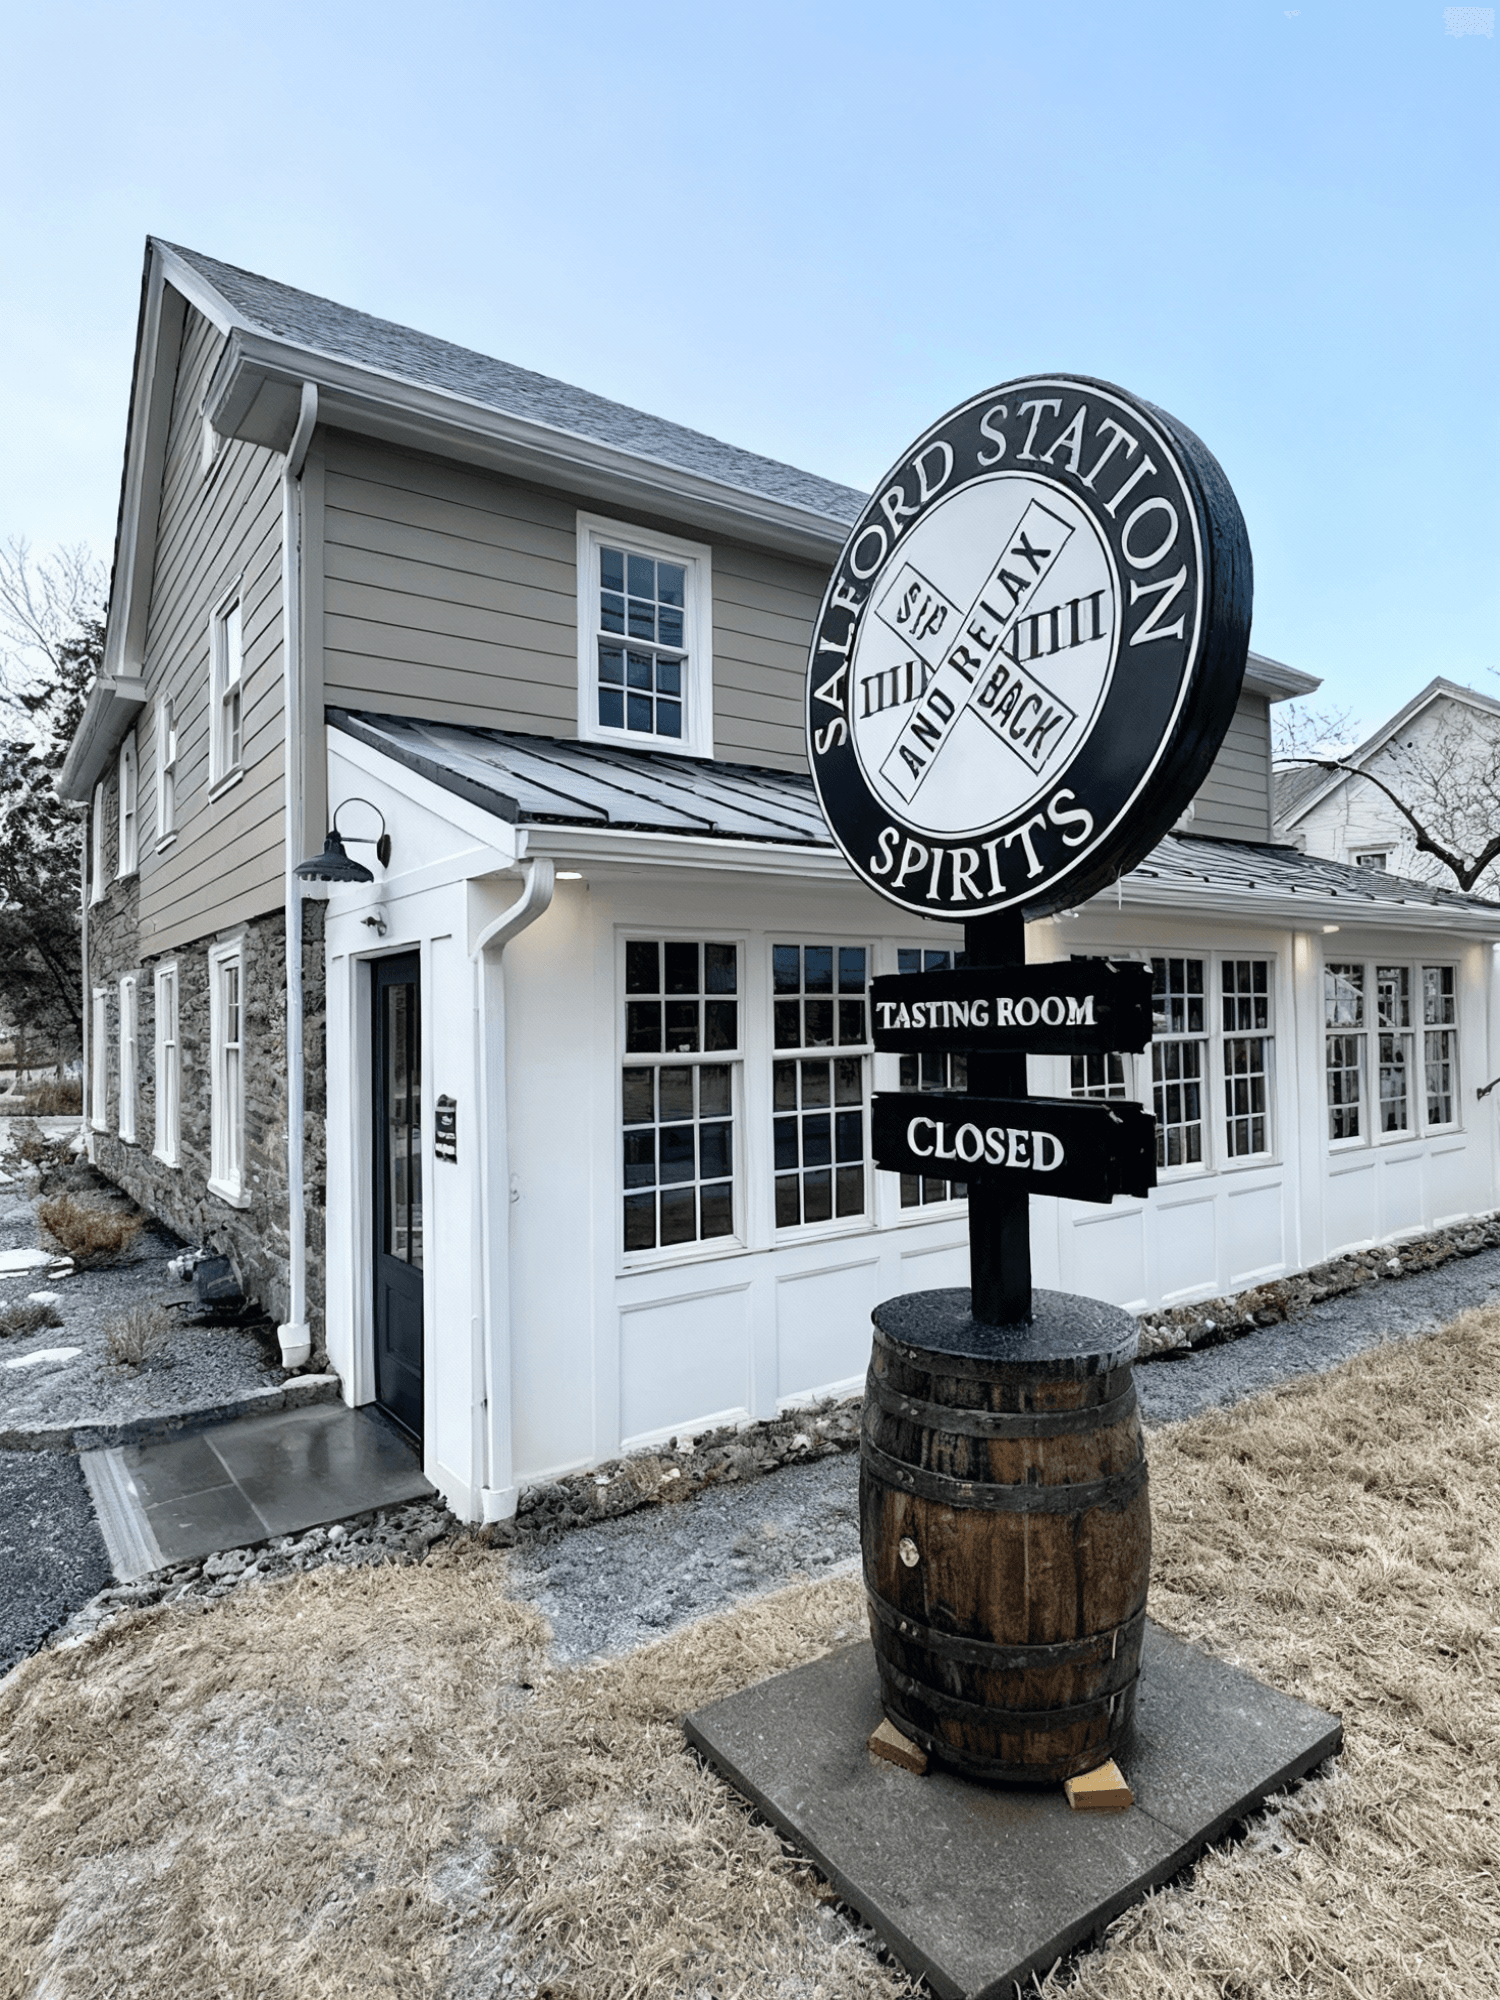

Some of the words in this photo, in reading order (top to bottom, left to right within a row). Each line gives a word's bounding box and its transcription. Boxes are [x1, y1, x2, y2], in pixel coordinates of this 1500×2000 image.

[814, 440, 954, 756] SALFORD
[977, 398, 1187, 647] STATION
[897, 582, 948, 640] SIP
[979, 664, 1064, 759] BACK
[899, 693, 955, 780] AND
[948, 531, 1052, 683] RELAX
[870, 788, 1094, 901] SPIRITS
[876, 1000, 989, 1029] TASTING
[996, 995, 1098, 1026] ROOM
[907, 1117, 1064, 1171] CLOSED
